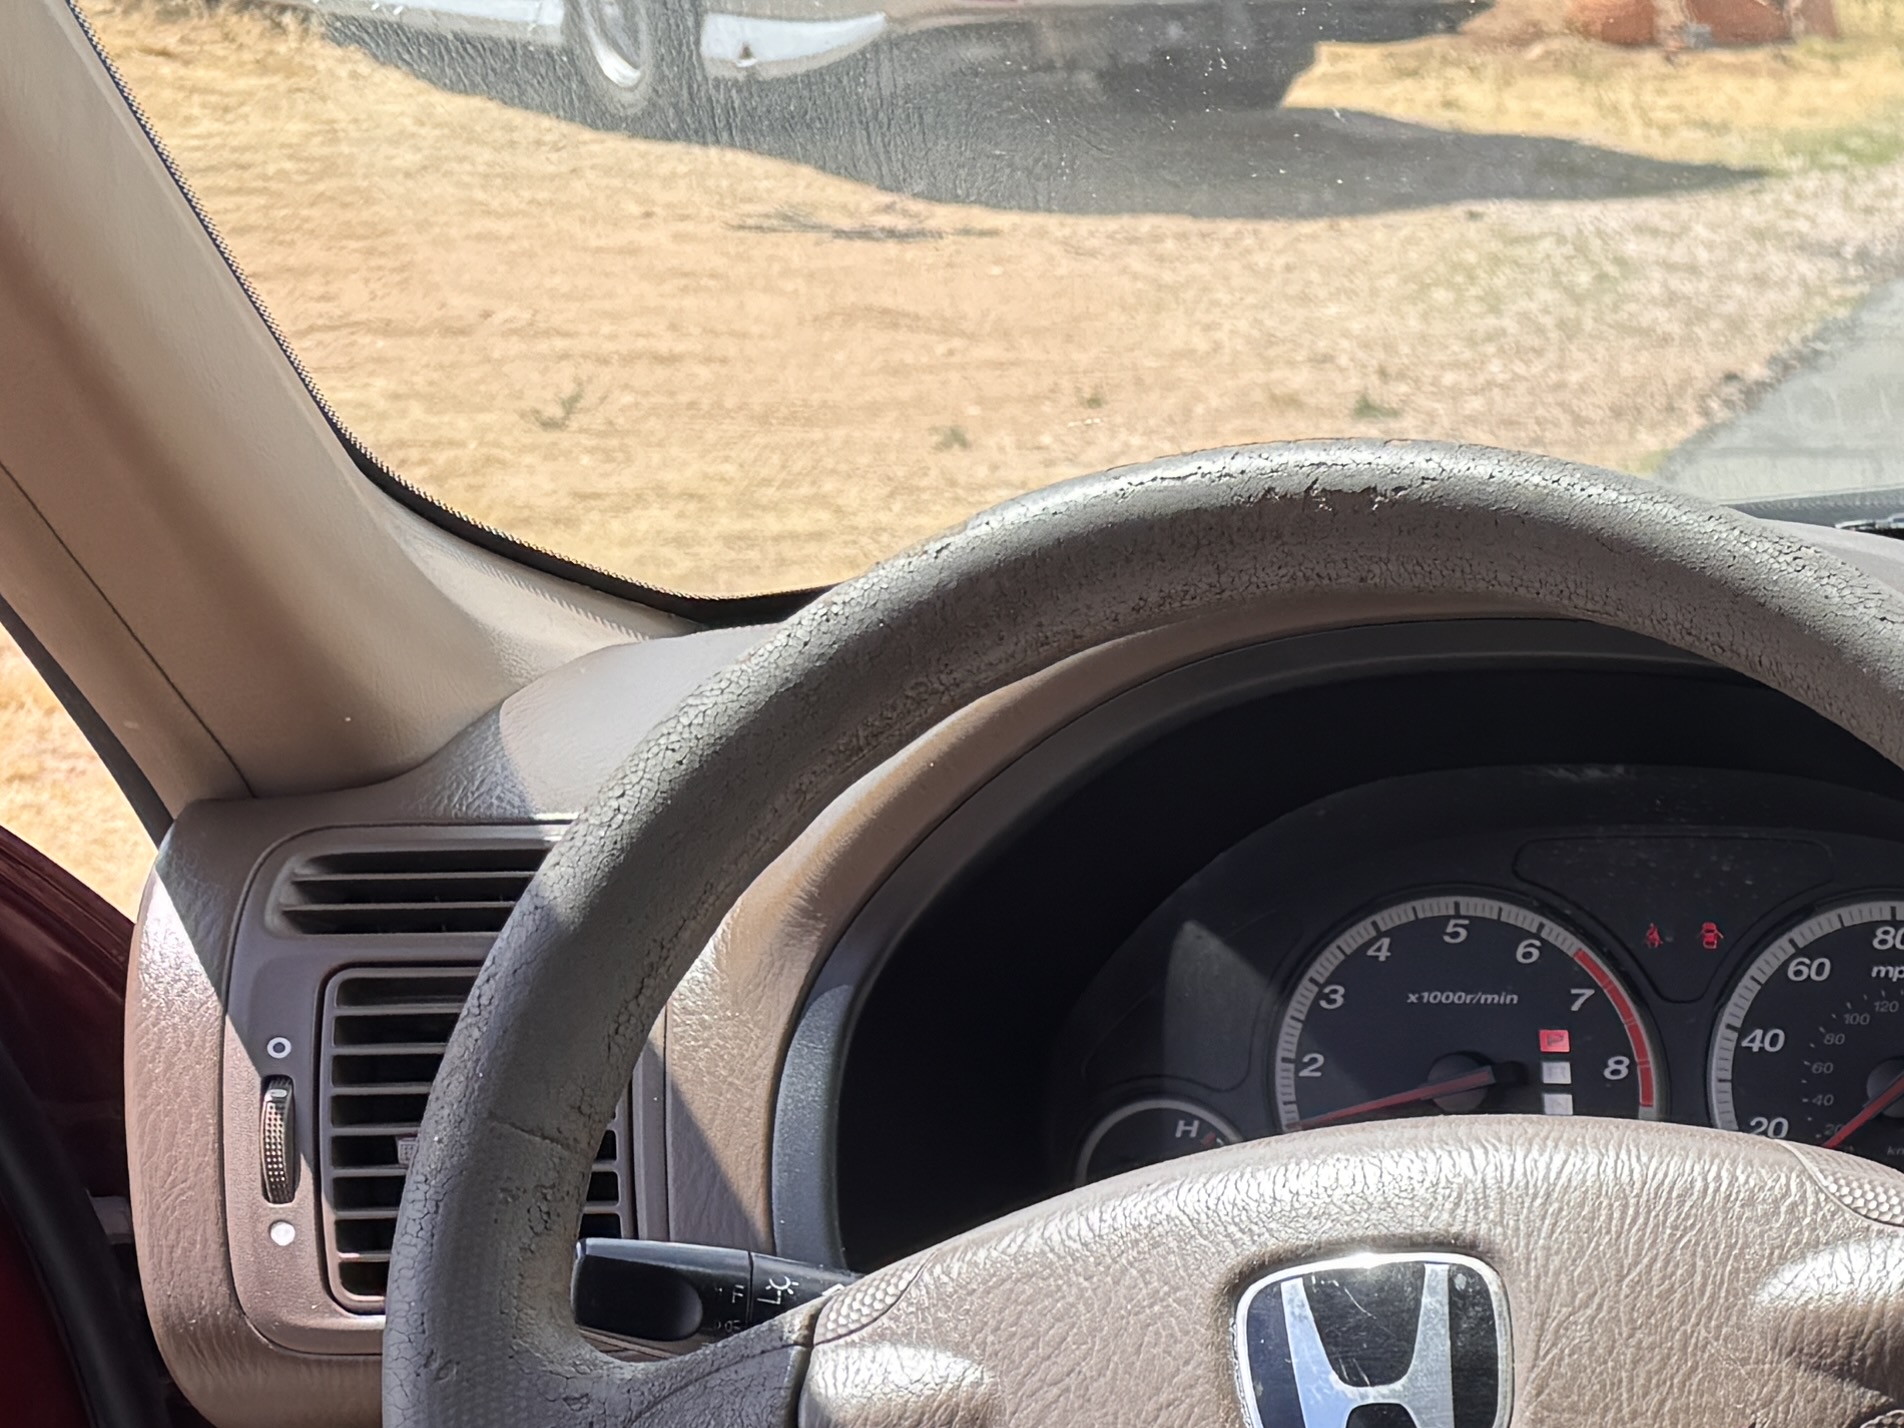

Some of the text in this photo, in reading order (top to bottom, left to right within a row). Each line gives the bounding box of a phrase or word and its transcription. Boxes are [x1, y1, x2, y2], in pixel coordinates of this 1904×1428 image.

[1443, 919, 1470, 944] 5
[1367, 938, 1391, 961] 4
[1515, 939, 1542, 964] 6
[1787, 957, 1831, 981] 60
[1319, 985, 1345, 1010] 3
[1407, 991, 1518, 1006] x1000r/min
[1570, 989, 1595, 1011] 7
[1874, 1000, 1899, 1014] 120
[1843, 1012, 1870, 1026] 100
[1741, 1029, 1785, 1053] 40
[1823, 1032, 1846, 1046] 80
[1299, 1054, 1325, 1077] 2
[1603, 1056, 1630, 1080] 8
[1811, 1061, 1834, 1075] 60
[1811, 1094, 1834, 1107] 40
[1175, 1120, 1200, 1138] H
[1749, 1116, 1789, 1139] 20
